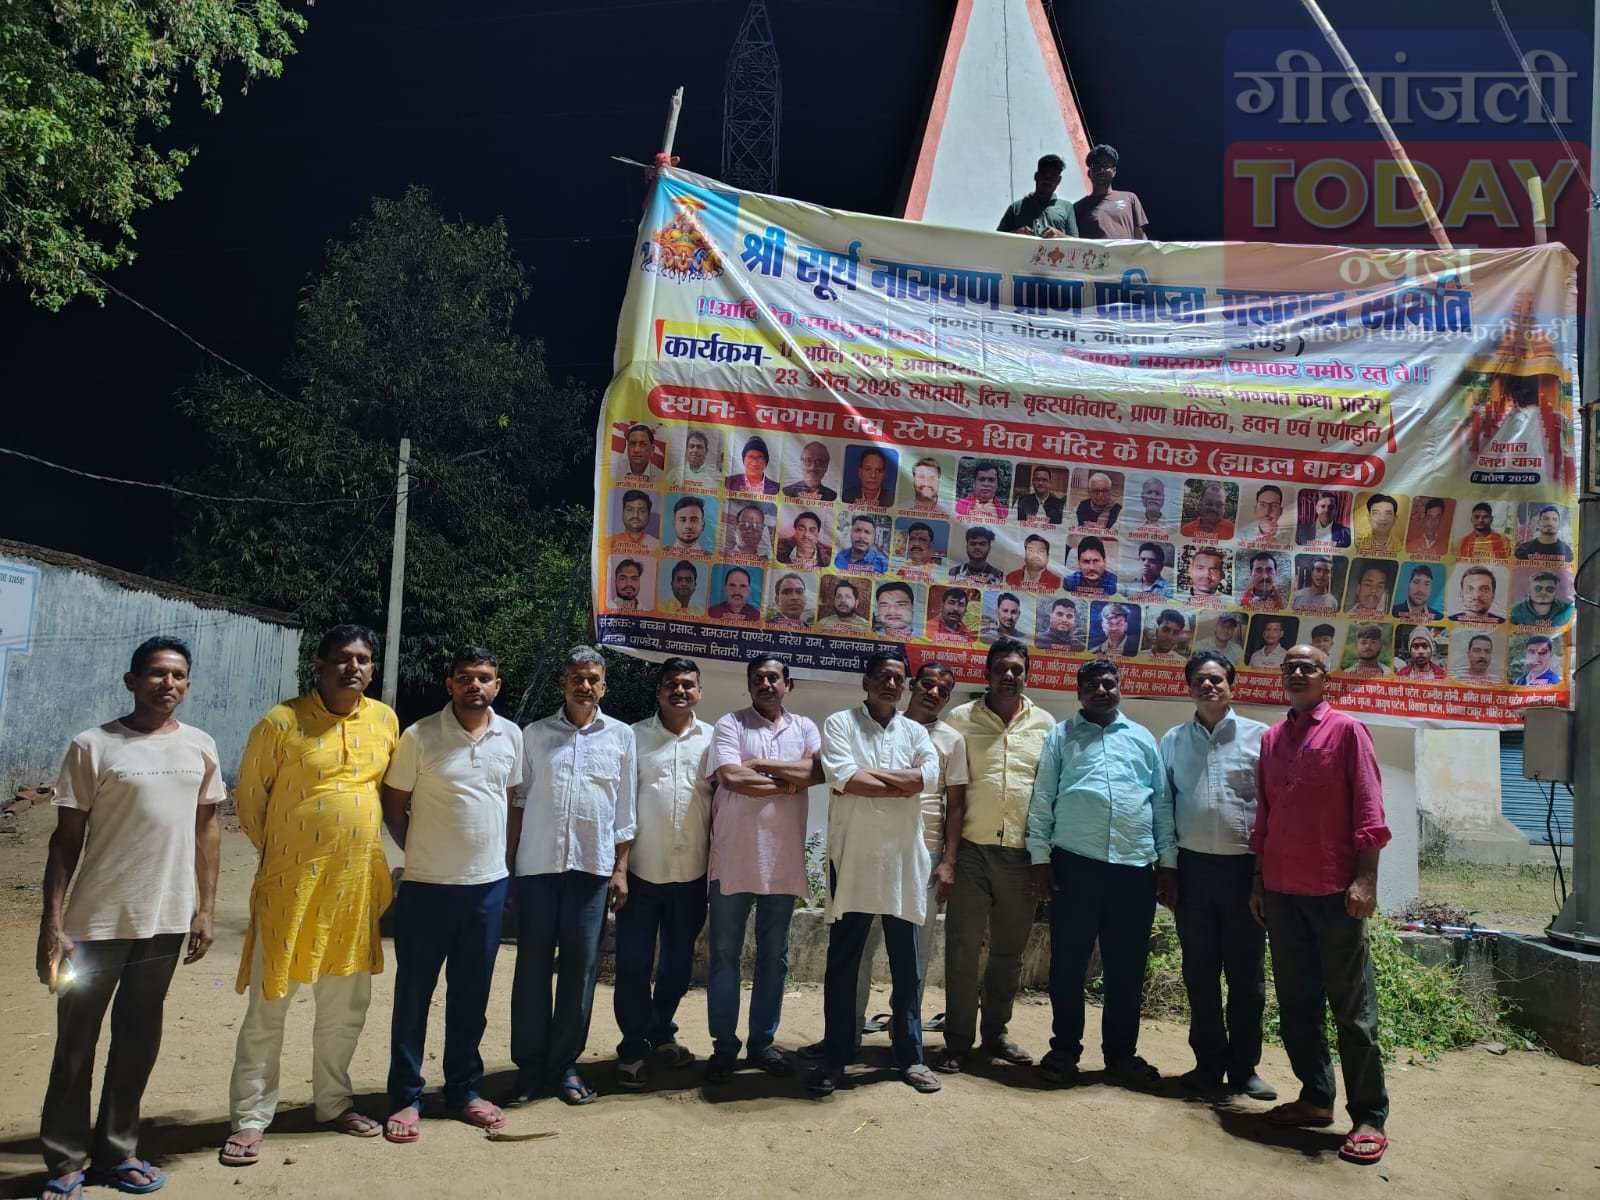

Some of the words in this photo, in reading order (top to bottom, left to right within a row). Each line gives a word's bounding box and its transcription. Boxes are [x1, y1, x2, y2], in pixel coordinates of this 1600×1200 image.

[740, 224, 788, 280] श्री
[796, 240, 862, 303] सूर्य
[870, 256, 1003, 311] नारायण
[1012, 274, 1085, 319] प्राण
[774, 367, 799, 386] 23
[855, 377, 901, 398] 2026
[1130, 403, 1168, 424] प्राण
[1241, 413, 1280, 435] हवन
[1286, 416, 1314, 438] एवं
[1296, 392, 1334, 411] कथा
[1338, 394, 1382, 415] प्रारंभ
[755, 404, 837, 431] लगमा
[843, 413, 886, 437] बस
[981, 423, 1035, 452] शिव
[1042, 429, 1107, 460] मंदिर
[1112, 436, 1138, 463] के
[1146, 440, 1201, 468] पिछे
[1511, 456, 1544, 469] यात्रा
[1507, 475, 1537, 483] 2026
[639, 619, 667, 633] बच्चन
[778, 632, 803, 646] नरेश
